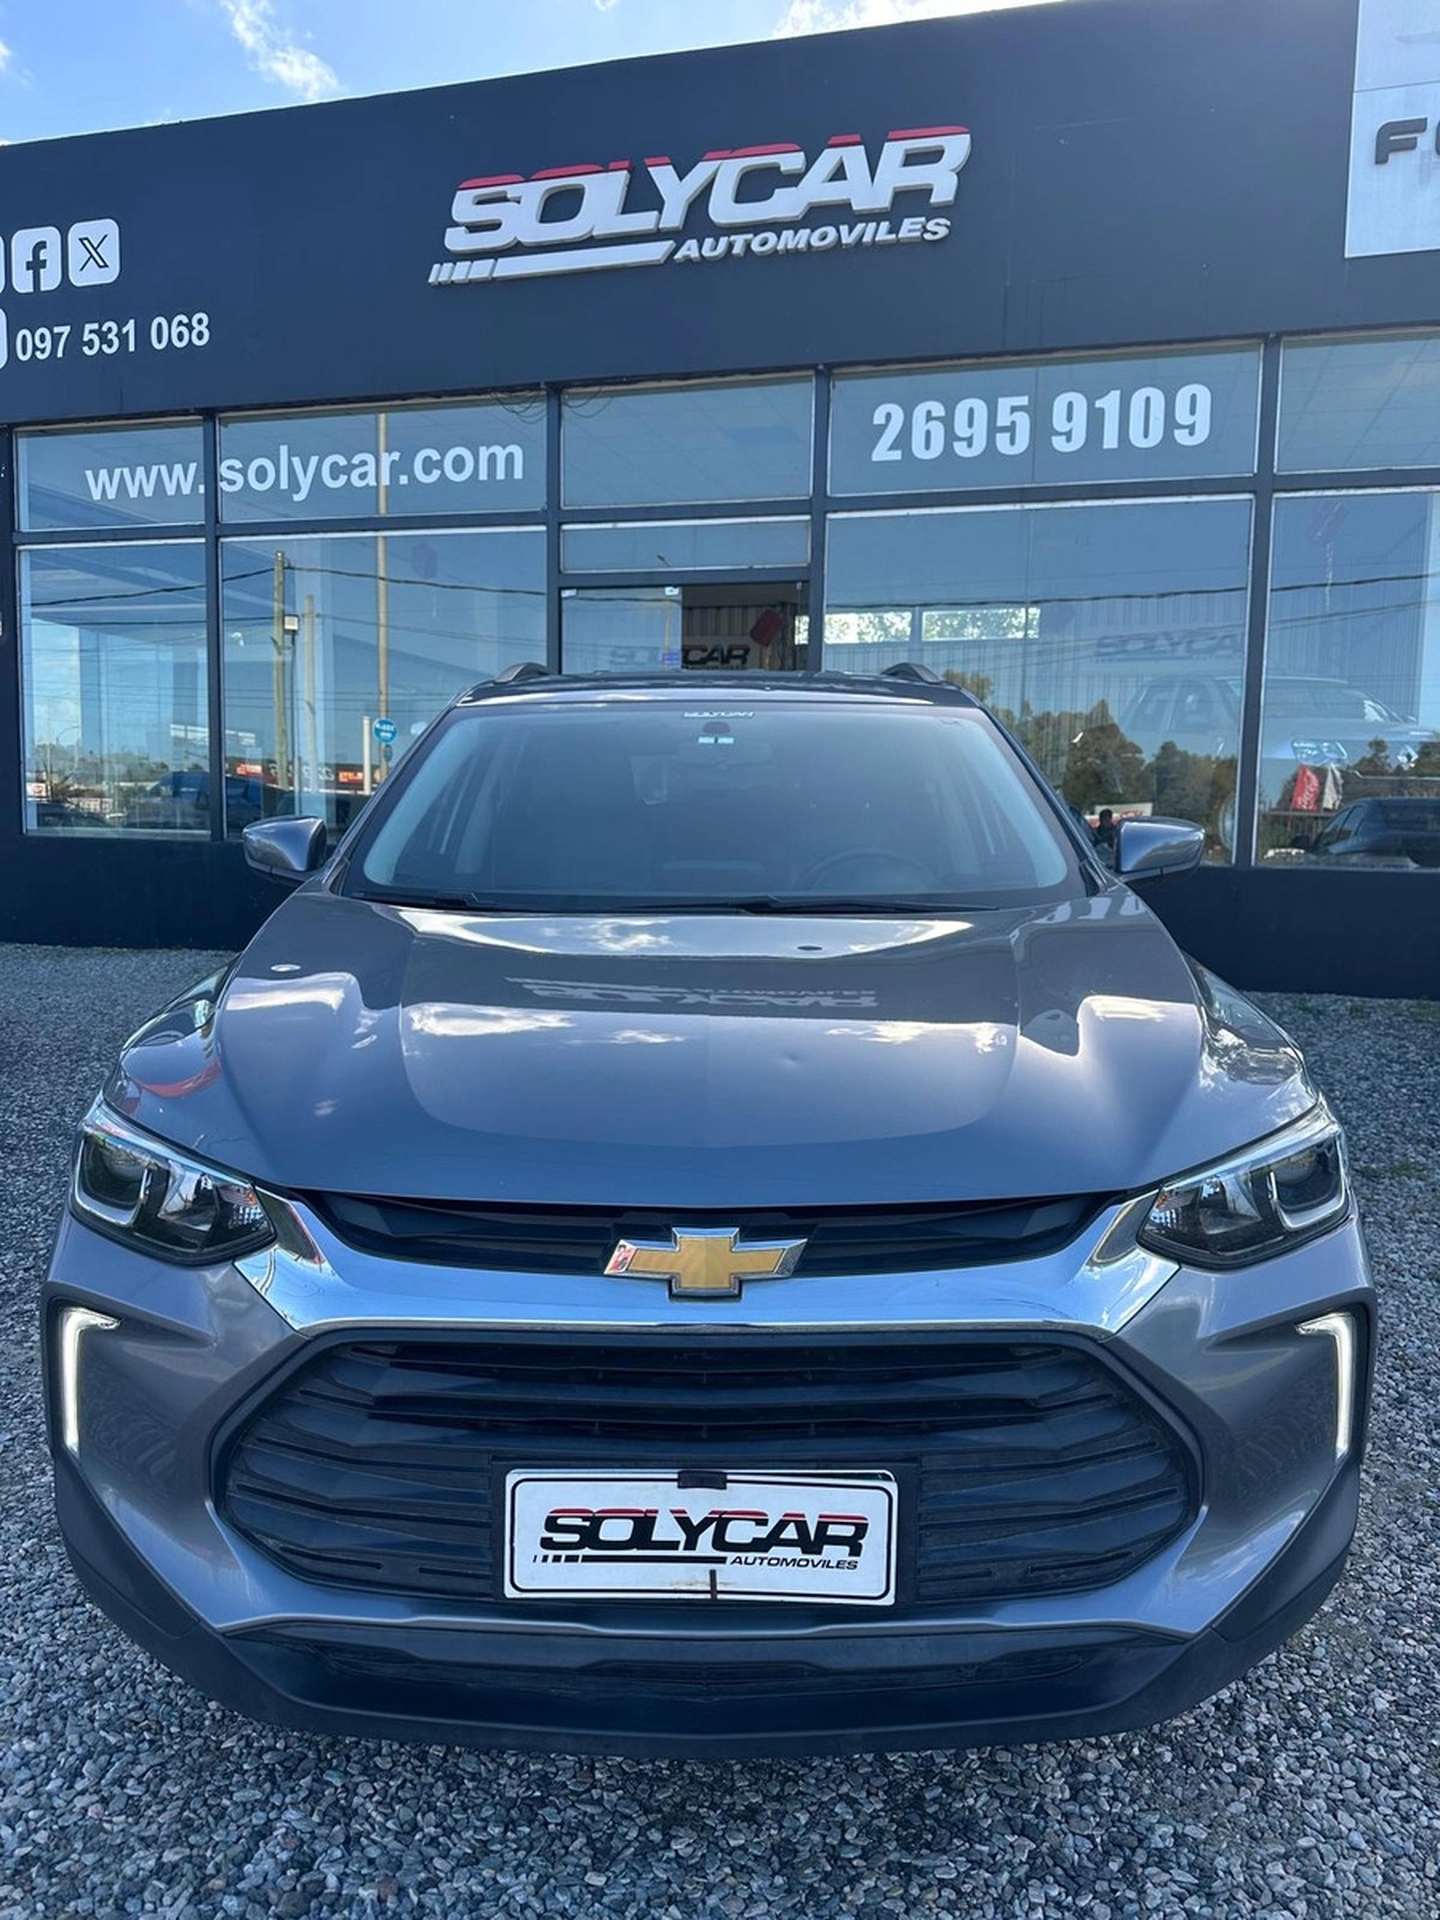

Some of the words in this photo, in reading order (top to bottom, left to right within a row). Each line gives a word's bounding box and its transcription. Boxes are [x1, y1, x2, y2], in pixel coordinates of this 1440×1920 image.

[443, 125, 971, 254] SOLYCAR
[673, 216, 951, 262] AUTOMOVILES
[15, 325, 71, 361] 097
[82, 319, 136, 356] 531
[151, 312, 210, 350] 068
[871, 395, 1031, 462] 2695
[1050, 383, 1212, 453] 9109
[539, 1507, 869, 1557] SOLYCAR
[730, 1555, 859, 1570] AUTOMOVILES
